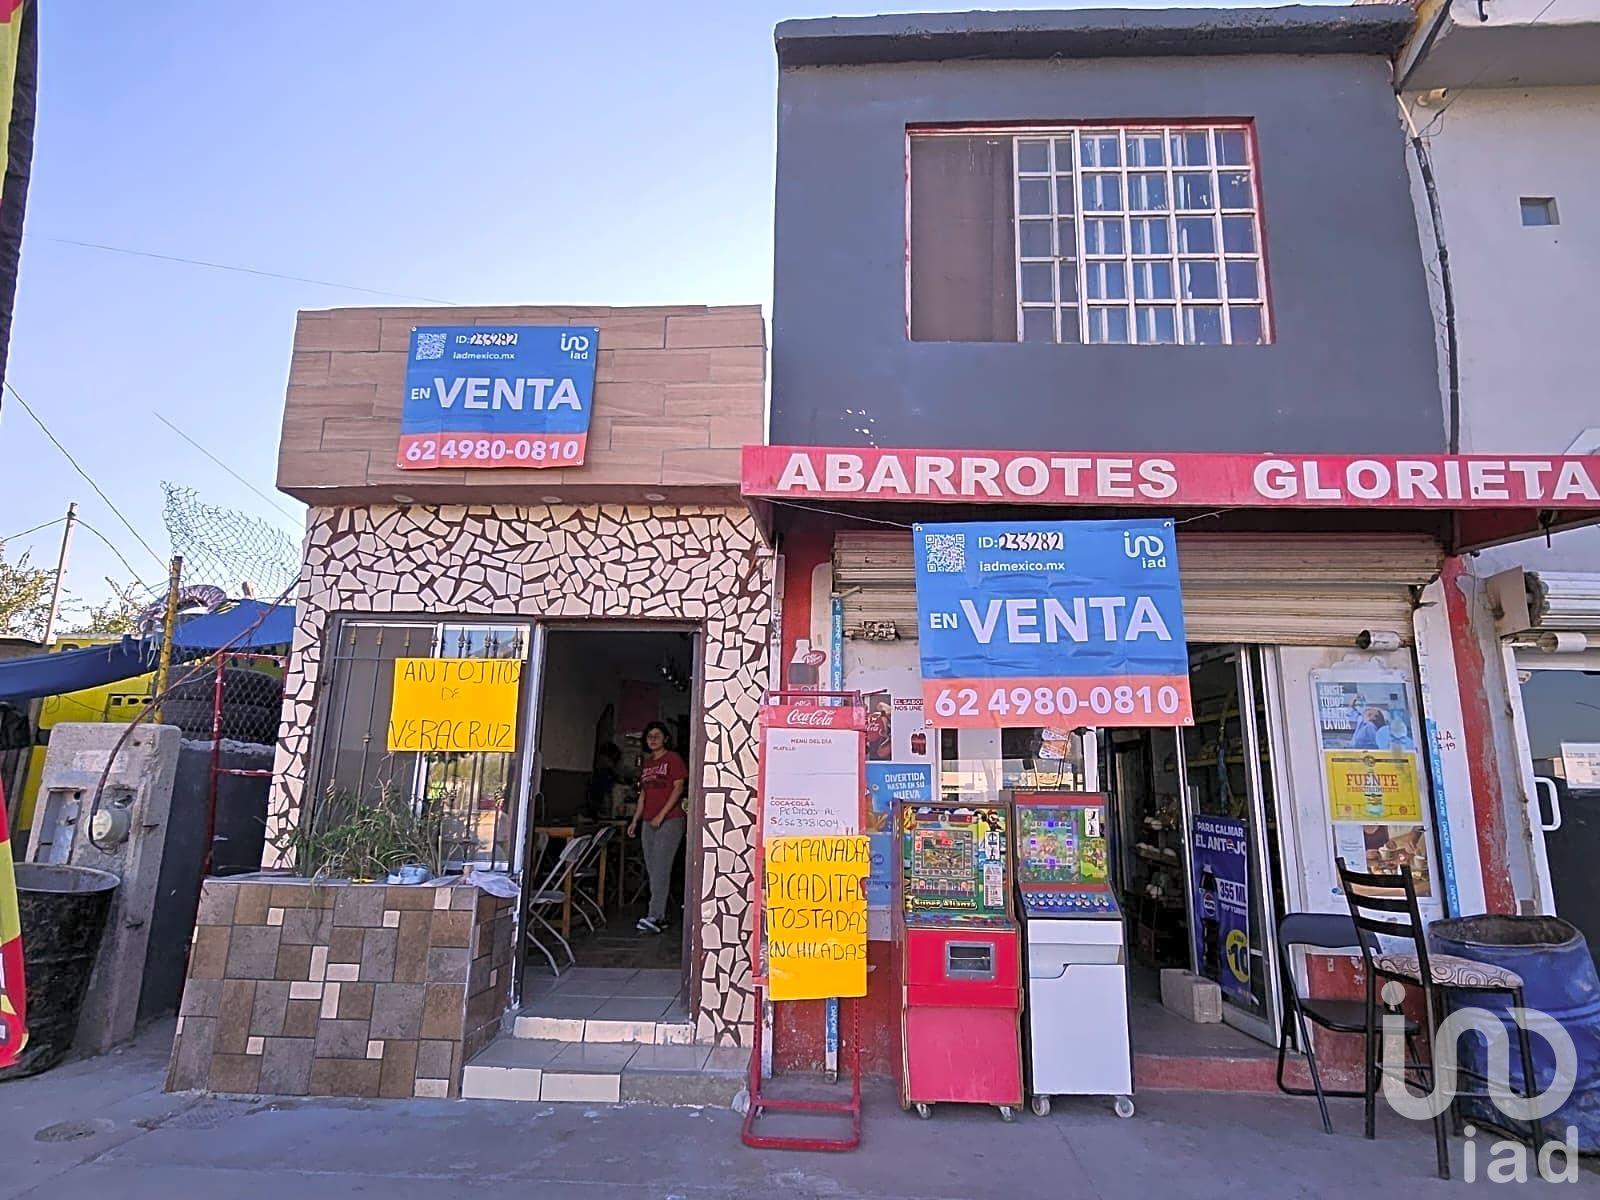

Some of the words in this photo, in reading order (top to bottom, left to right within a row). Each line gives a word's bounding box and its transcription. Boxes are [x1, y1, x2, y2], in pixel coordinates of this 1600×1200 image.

[452, 351, 516, 360] iadmexico.mx
[410, 387, 431, 400] EN
[433, 377, 582, 411] VENTA
[406, 441, 437, 461] 62
[440, 439, 579, 461] 4980-0810
[776, 453, 1178, 499] ABARROTES
[1253, 459, 1600, 501] GLORIETA
[979, 561, 1066, 572] iadmexico.mx
[1141, 557, 1167, 569] iad
[930, 612, 958, 629] EN
[959, 597, 1173, 644] VENTA
[935, 689, 979, 717] 62
[987, 685, 1180, 716] 4980-0810
[390, 719, 513, 750] VERACRUZ
[884, 772, 925, 782] DIVERTIDA
[1345, 773, 1399, 786] FUENTE
[893, 790, 921, 799] NUEVA
[1197, 821, 1214, 833] PARA
[1215, 824, 1244, 838] CALMAR
[1195, 834, 1207, 849] EL
[1219, 881, 1235, 900] 355
